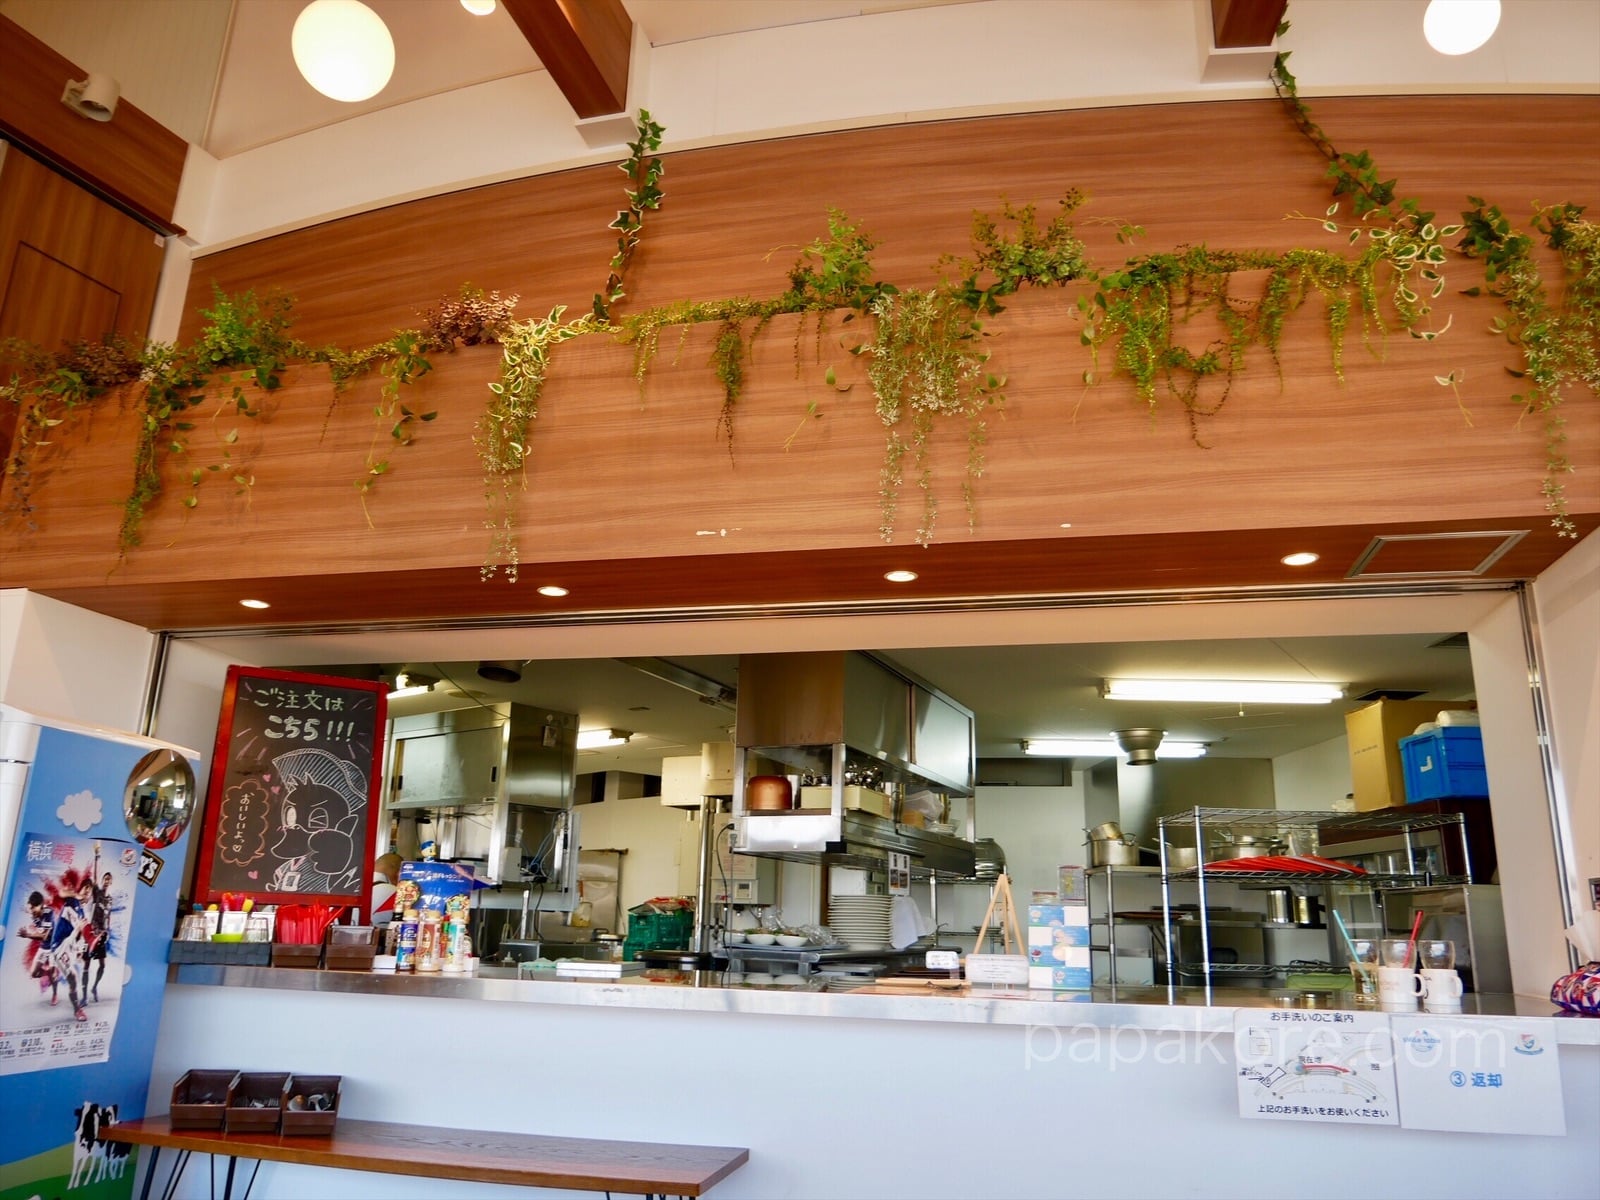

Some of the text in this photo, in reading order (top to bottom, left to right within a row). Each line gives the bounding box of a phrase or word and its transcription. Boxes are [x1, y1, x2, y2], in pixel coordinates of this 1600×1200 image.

[253, 689, 345, 712] ご注文は
[1270, 1012, 1354, 1023] お手洗いのご案内
[1471, 1072, 1503, 1088] 返却
[1258, 1104, 1389, 1118] 上記のお手洗いをお使いください
